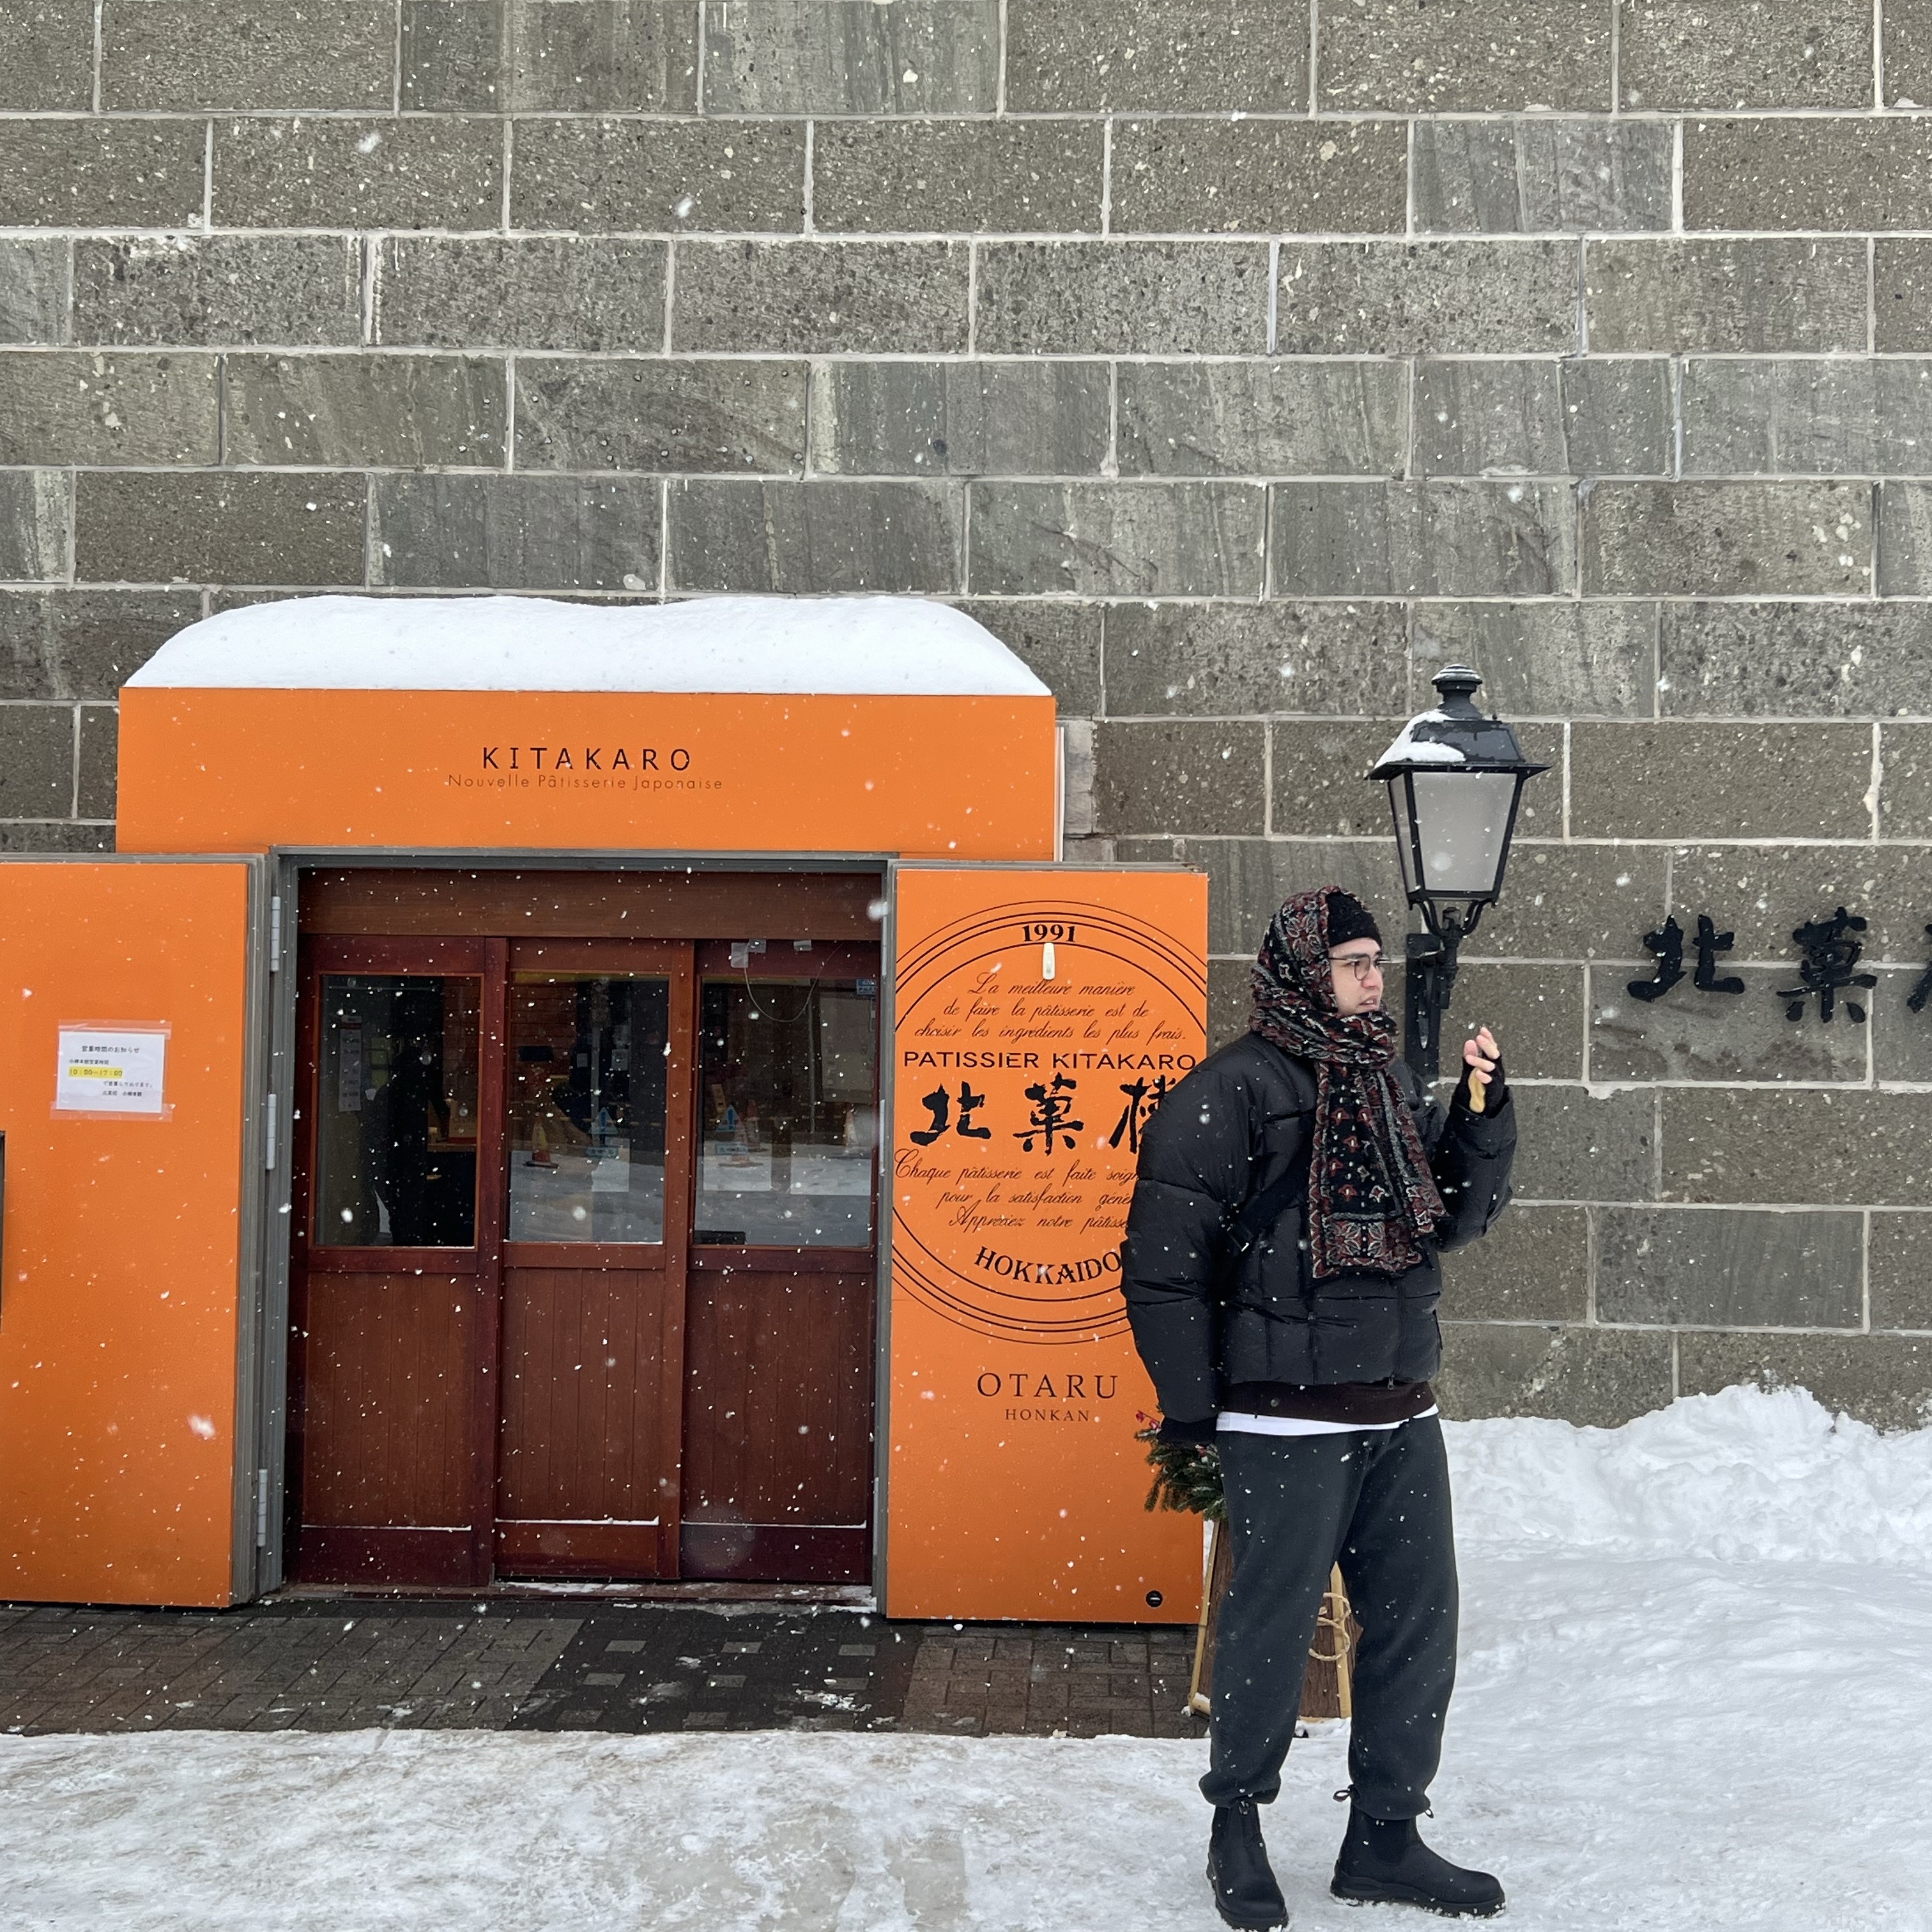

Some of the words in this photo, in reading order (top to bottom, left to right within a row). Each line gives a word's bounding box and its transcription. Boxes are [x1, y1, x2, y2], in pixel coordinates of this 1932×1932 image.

[482, 747, 691, 771] KITAKARO
[448, 774, 529, 788] Nouvelle
[539, 774, 625, 788] Pâtisserie
[632, 775, 722, 792] Japonaise
[1022, 924, 1076, 942] 1991
[1627, 906, 1932, 1024] 北菓
[967, 971, 999, 995] La
[1008, 977, 1073, 995] meilleure
[1078, 981, 1135, 995] manière
[944, 998, 960, 1016] de
[965, 996, 1000, 1022] faire
[1011, 997, 1026, 1016] la
[1028, 1004, 1095, 1022] pâtisserie
[1105, 1003, 1126, 1017] est
[1132, 1000, 1149, 1017] de
[914, 1018, 962, 1037] choisir
[972, 1018, 990, 1038] les
[999, 1021, 1074, 1044] ingrédients
[1083, 1020, 1101, 1039] les
[1105, 1020, 1140, 1045] plus
[1146, 1020, 1186, 1046] frais.
[82, 1045, 140, 1054] 営業時間のお知らせ
[904, 1052, 1039, 1068] PATISSIER
[1052, 1053, 1197, 1070] KITAKARO
[894, 1148, 951, 1185] Chaque
[955, 1167, 1022, 1186] pâtisserie
[1034, 1167, 1055, 1179] est
[1062, 1159, 1096, 1187] faite
[1106, 1169, 1138, 1186] soign
[935, 1192, 974, 1209] pour
[985, 1183, 1001, 1202] la
[1008, 1183, 1082, 1210] satisfaction
[1094, 1192, 1131, 1211] géné
[1036, 1215, 1073, 1227] notre
[1080, 1216, 1127, 1234] pâtisse
[974, 1246, 1123, 1285] HOKKAIDO
[977, 1373, 1119, 1399] OTARU
[1005, 1409, 1089, 1422] HONKAN
